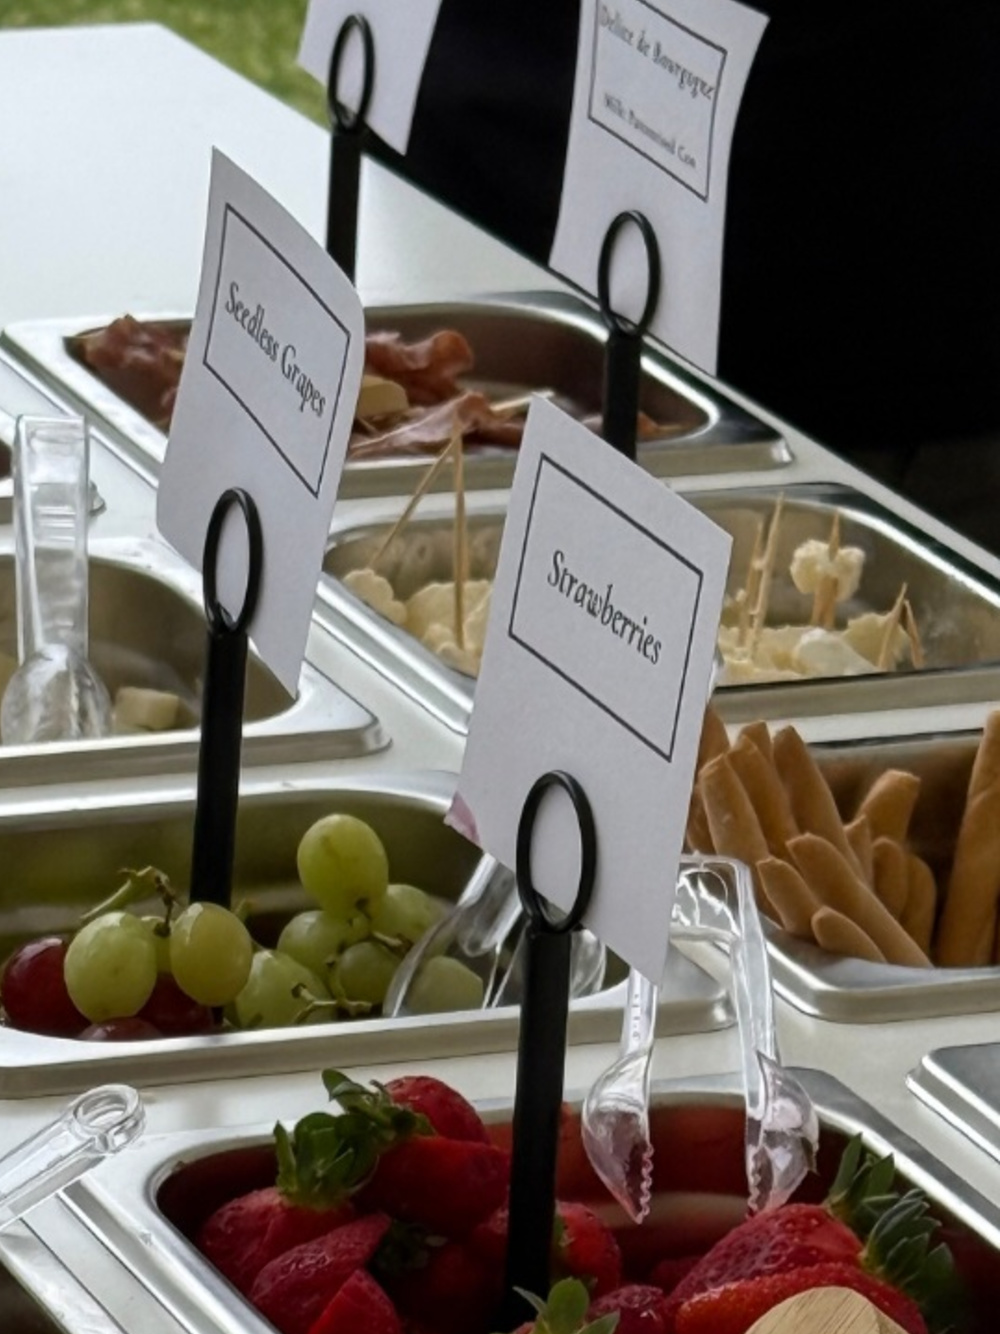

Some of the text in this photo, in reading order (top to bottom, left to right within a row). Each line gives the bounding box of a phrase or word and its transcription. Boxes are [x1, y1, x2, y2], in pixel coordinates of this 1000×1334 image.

[225, 281, 327, 418] Seedless Grapes
[547, 550, 663, 665] Strawberries
